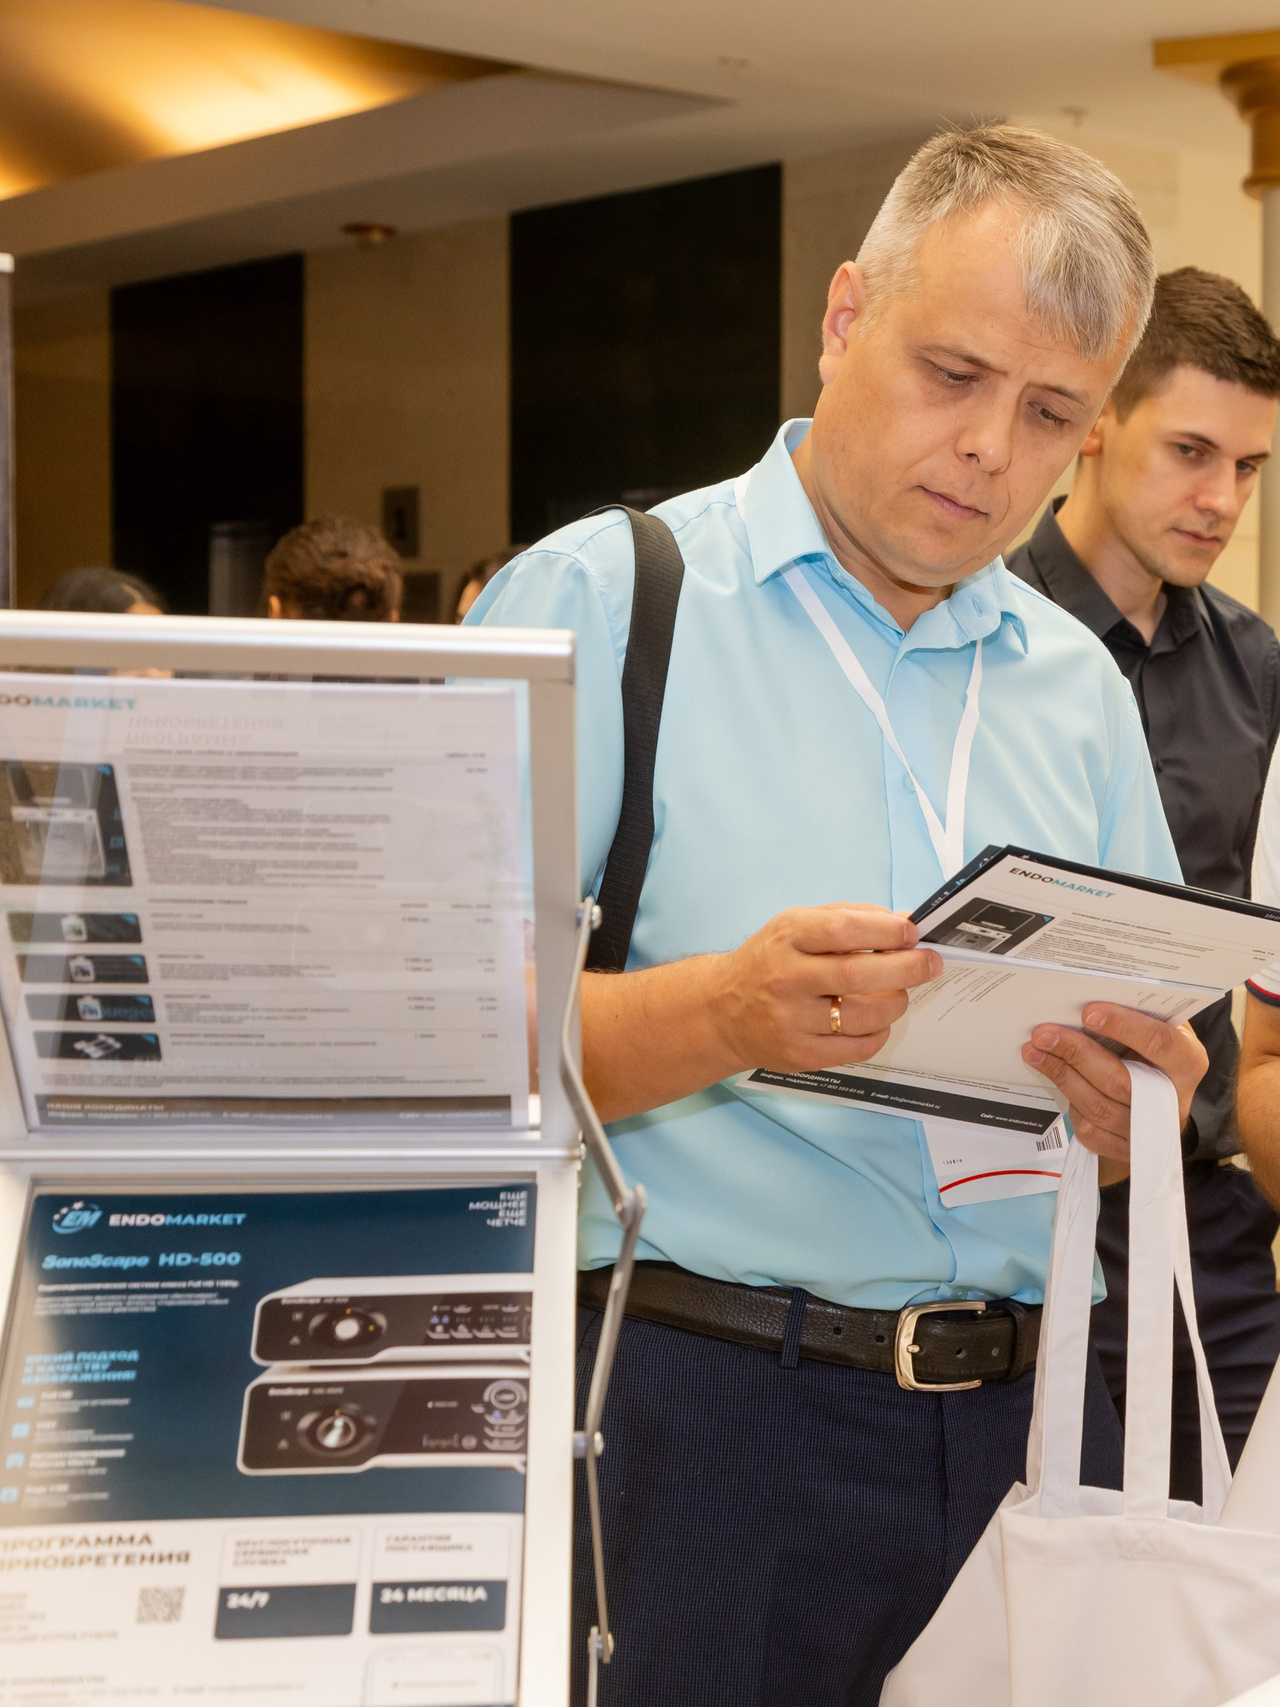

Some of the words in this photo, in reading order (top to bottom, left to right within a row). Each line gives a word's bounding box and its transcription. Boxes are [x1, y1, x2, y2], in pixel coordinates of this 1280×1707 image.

[1008, 867, 1116, 899] ENDOMARKET
[108, 1213, 247, 1227] ENDOMARKET
[42, 1254, 150, 1270] SonoScape
[158, 1251, 242, 1267] HD-500
[226, 1591, 270, 1609] 24/7
[407, 1586, 488, 1603] МЕСЯЦА
